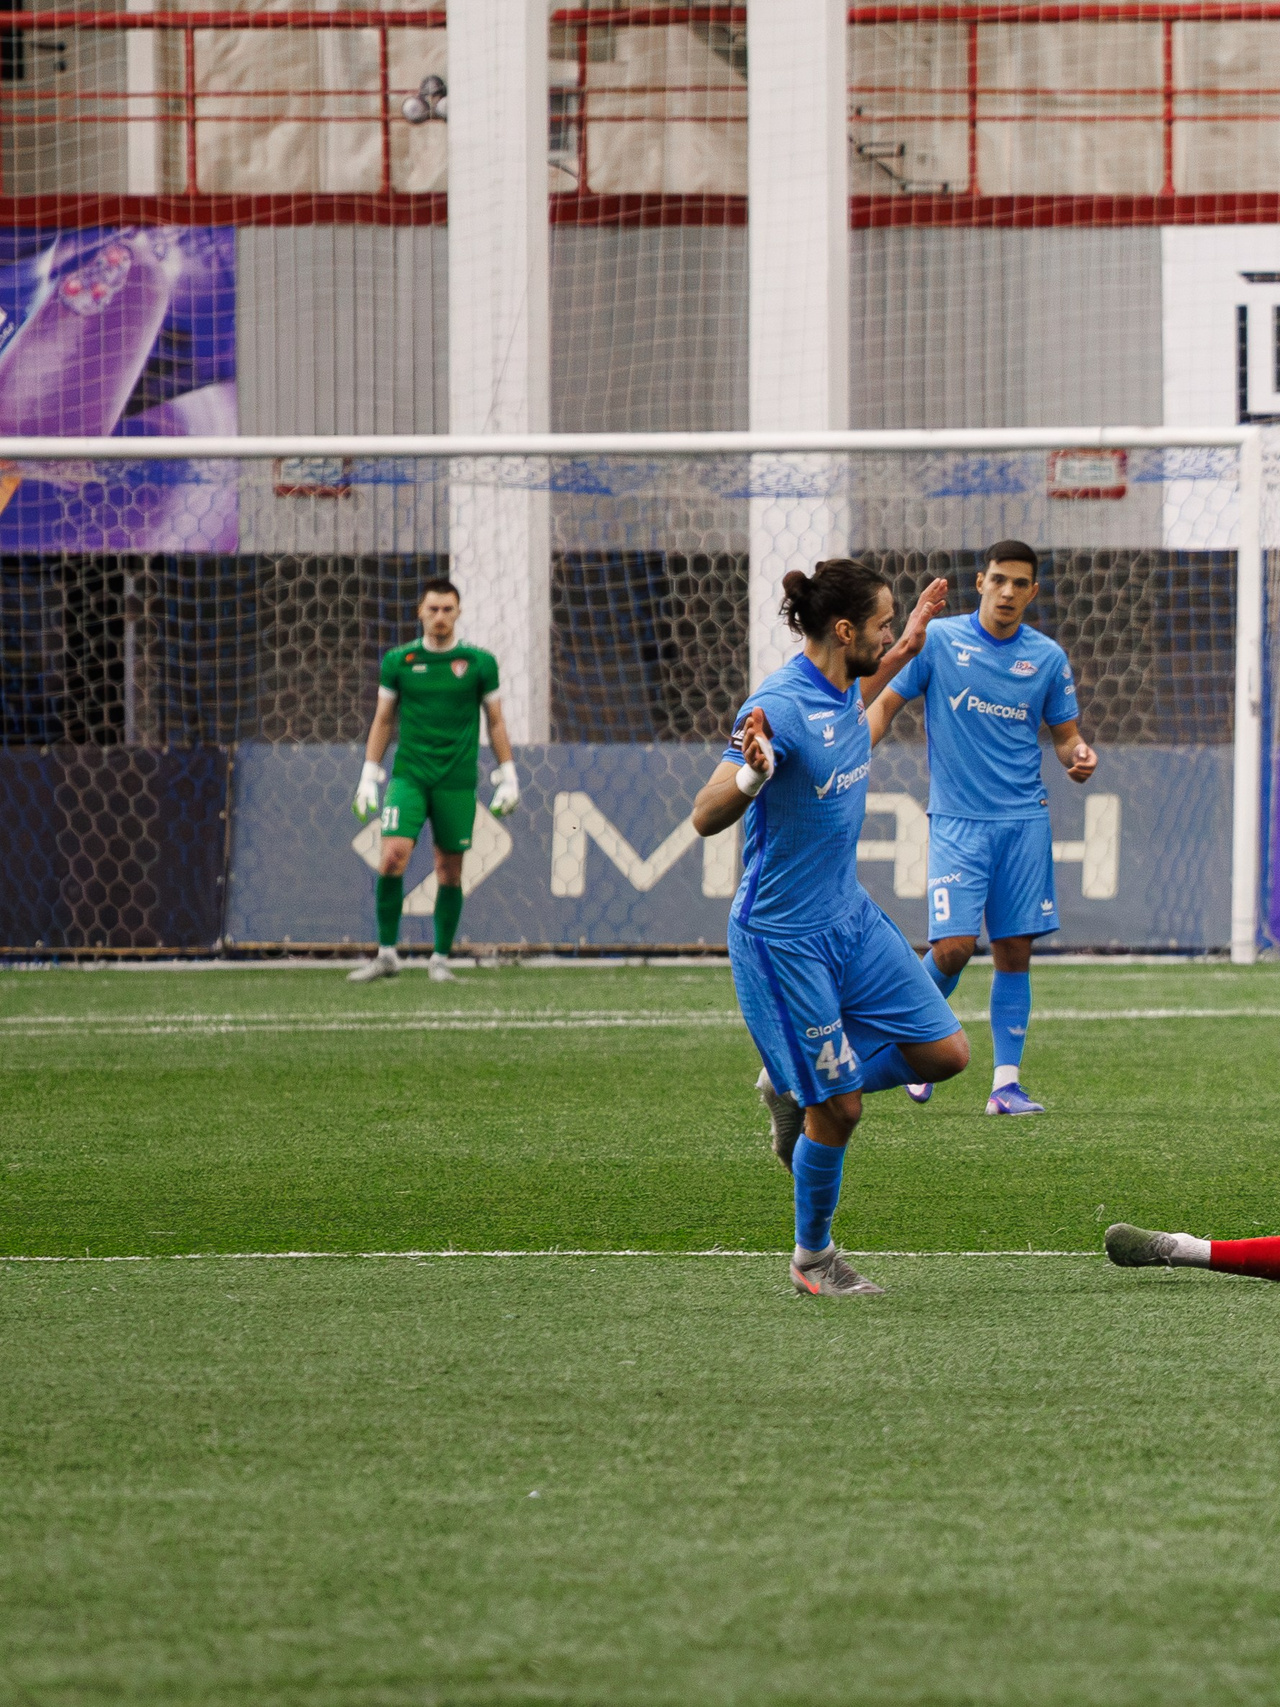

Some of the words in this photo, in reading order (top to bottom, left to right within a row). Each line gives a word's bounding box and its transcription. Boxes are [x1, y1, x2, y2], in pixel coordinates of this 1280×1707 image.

[967, 695, 1028, 721] Рексона
[933, 887, 951, 921] 9
[815, 1031, 857, 1080] 44
